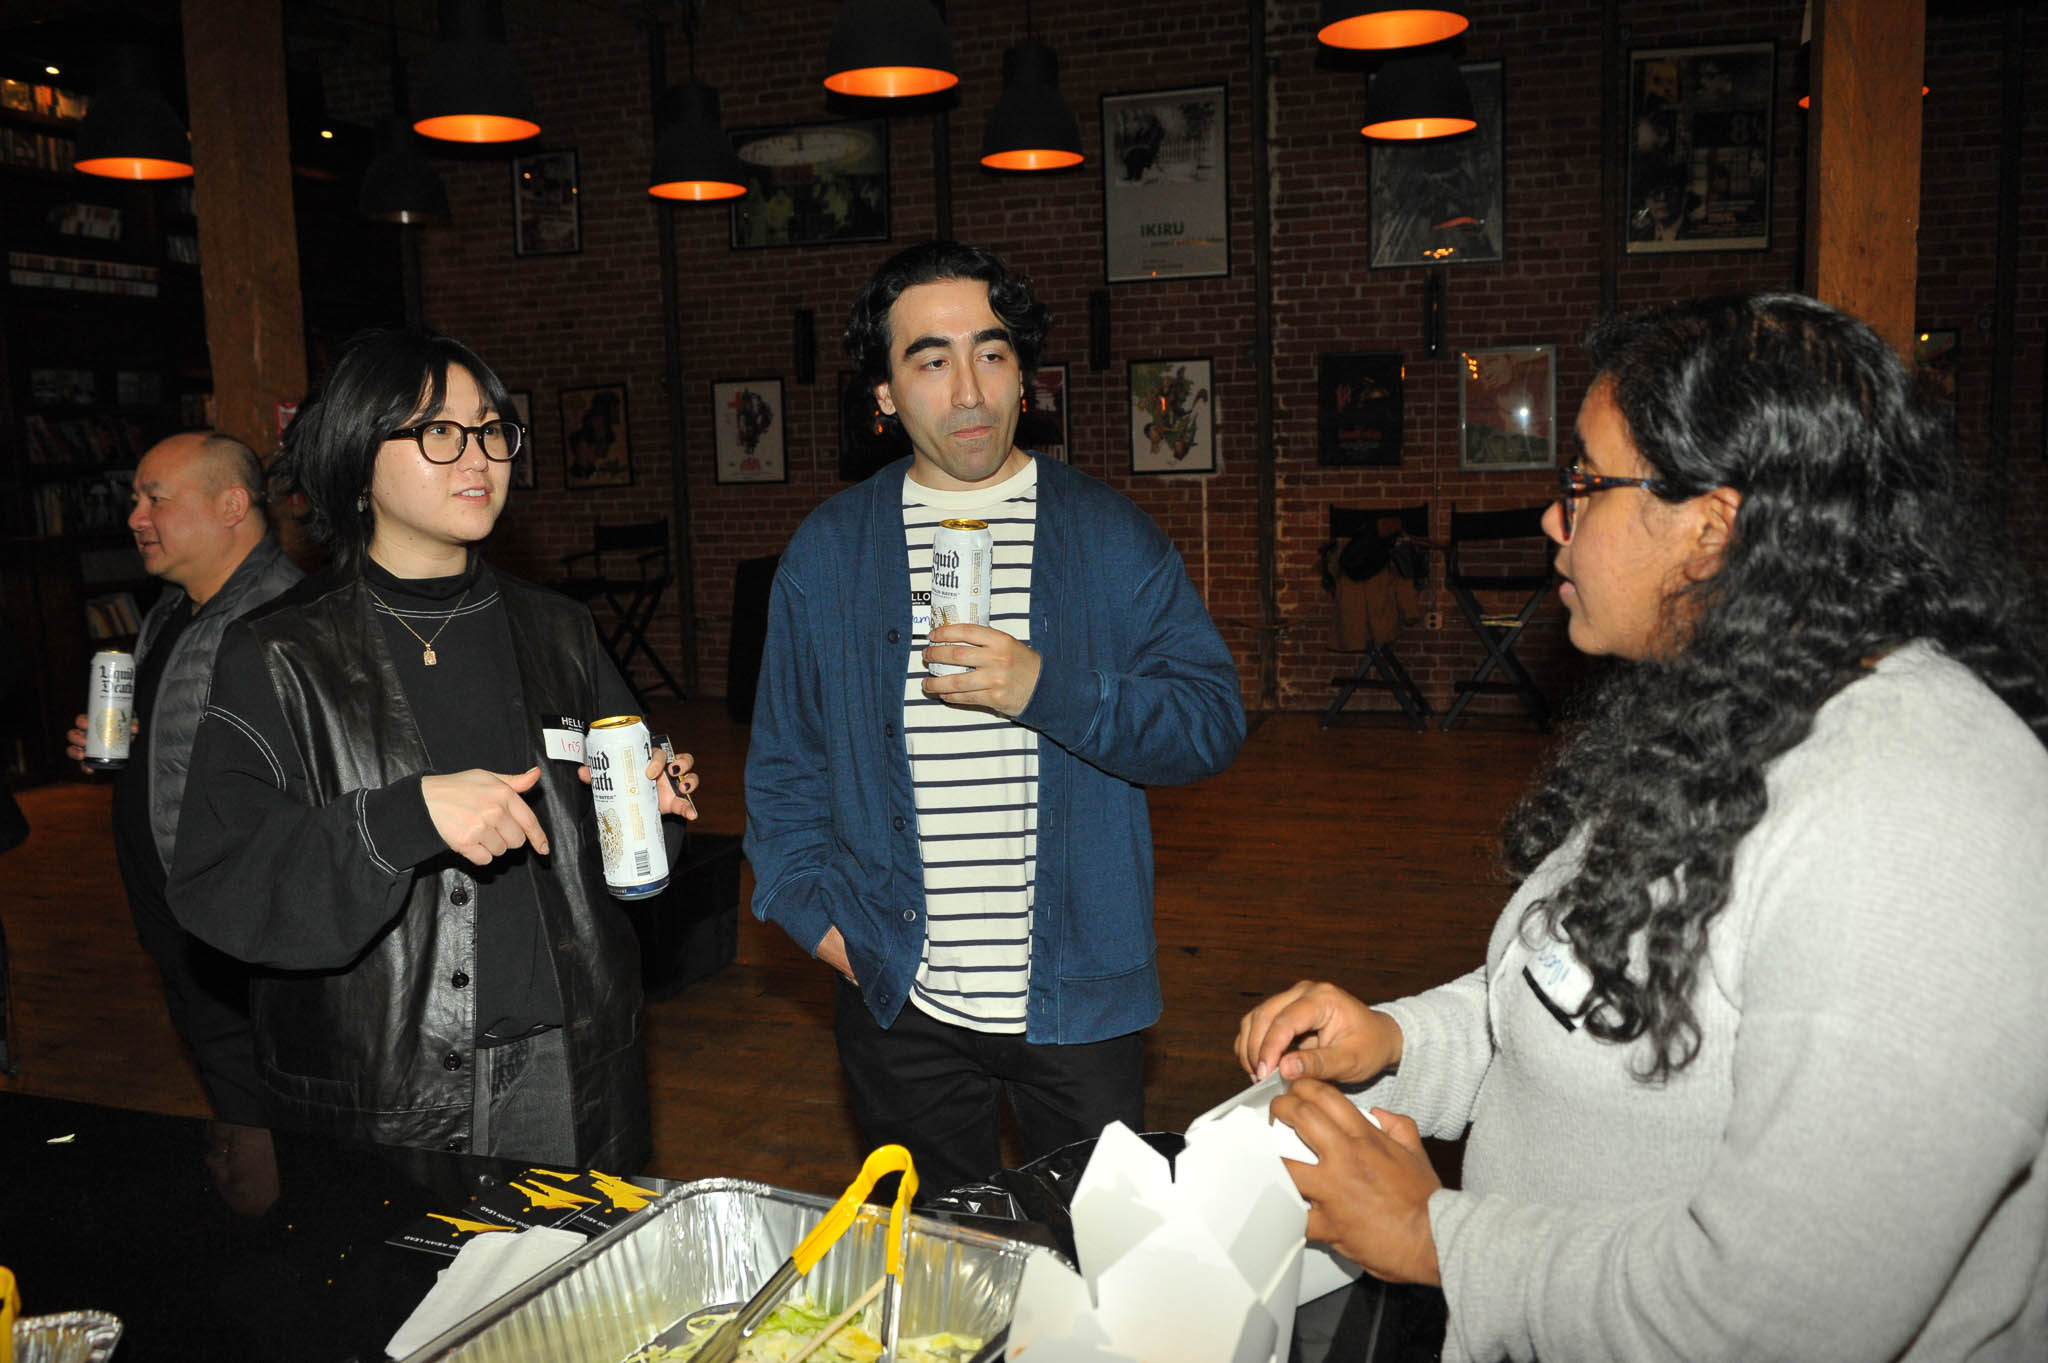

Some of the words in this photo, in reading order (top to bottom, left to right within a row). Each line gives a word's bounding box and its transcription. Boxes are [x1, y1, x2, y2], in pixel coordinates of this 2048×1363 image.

[1140, 221, 1185, 238] IKIRU
[912, 593, 931, 601] LLO
[100, 664, 134, 682] Lquid
